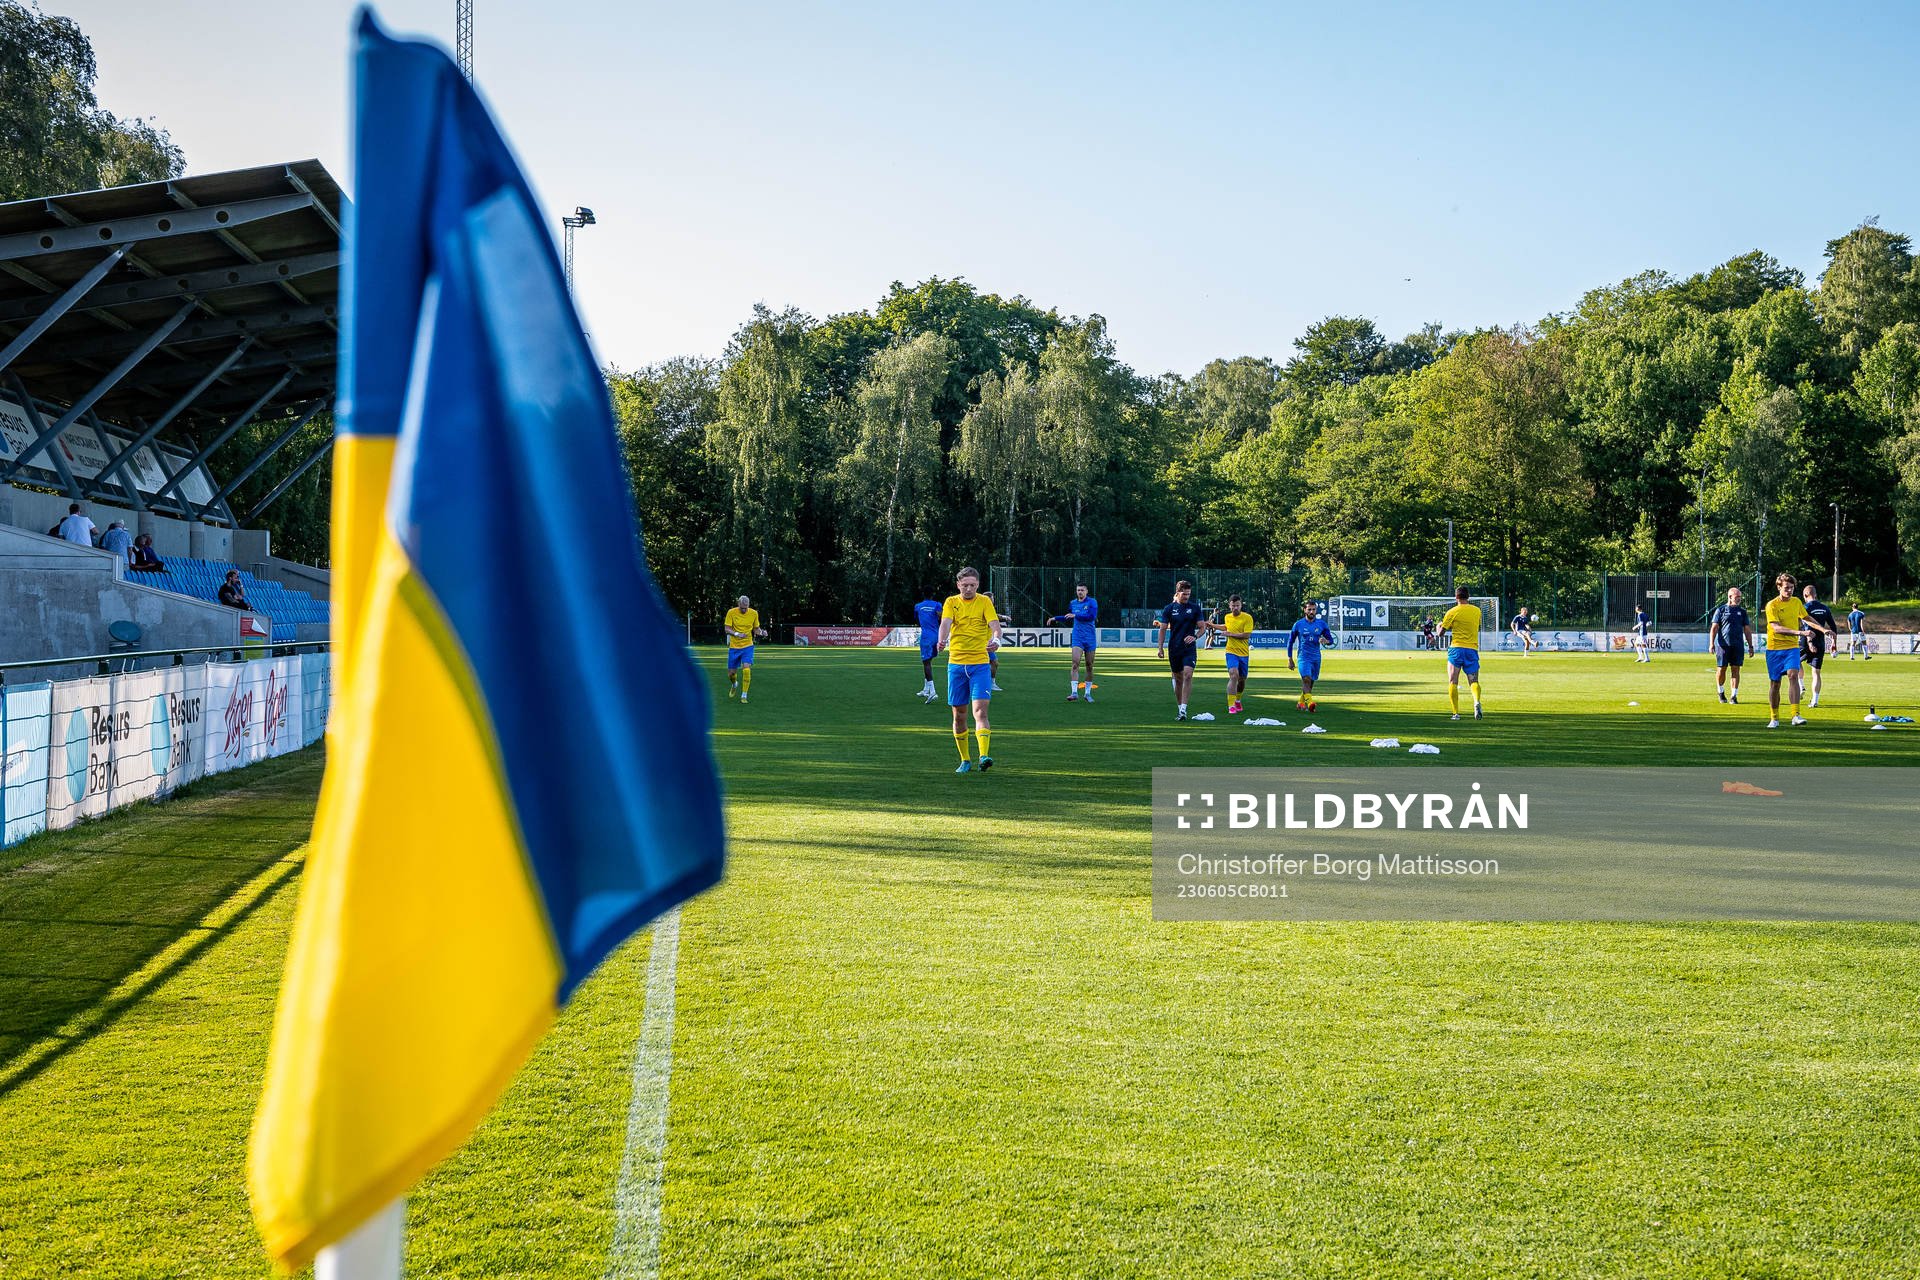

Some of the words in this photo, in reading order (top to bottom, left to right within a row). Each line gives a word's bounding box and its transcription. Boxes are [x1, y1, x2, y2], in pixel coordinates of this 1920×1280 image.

[1002, 628, 1074, 648] stadiu
[1630, 636, 1672, 649] SNEÄGG
[91, 705, 130, 747] Resurs
[170, 692, 201, 729] Resurs
[90, 749, 119, 795] Bank
